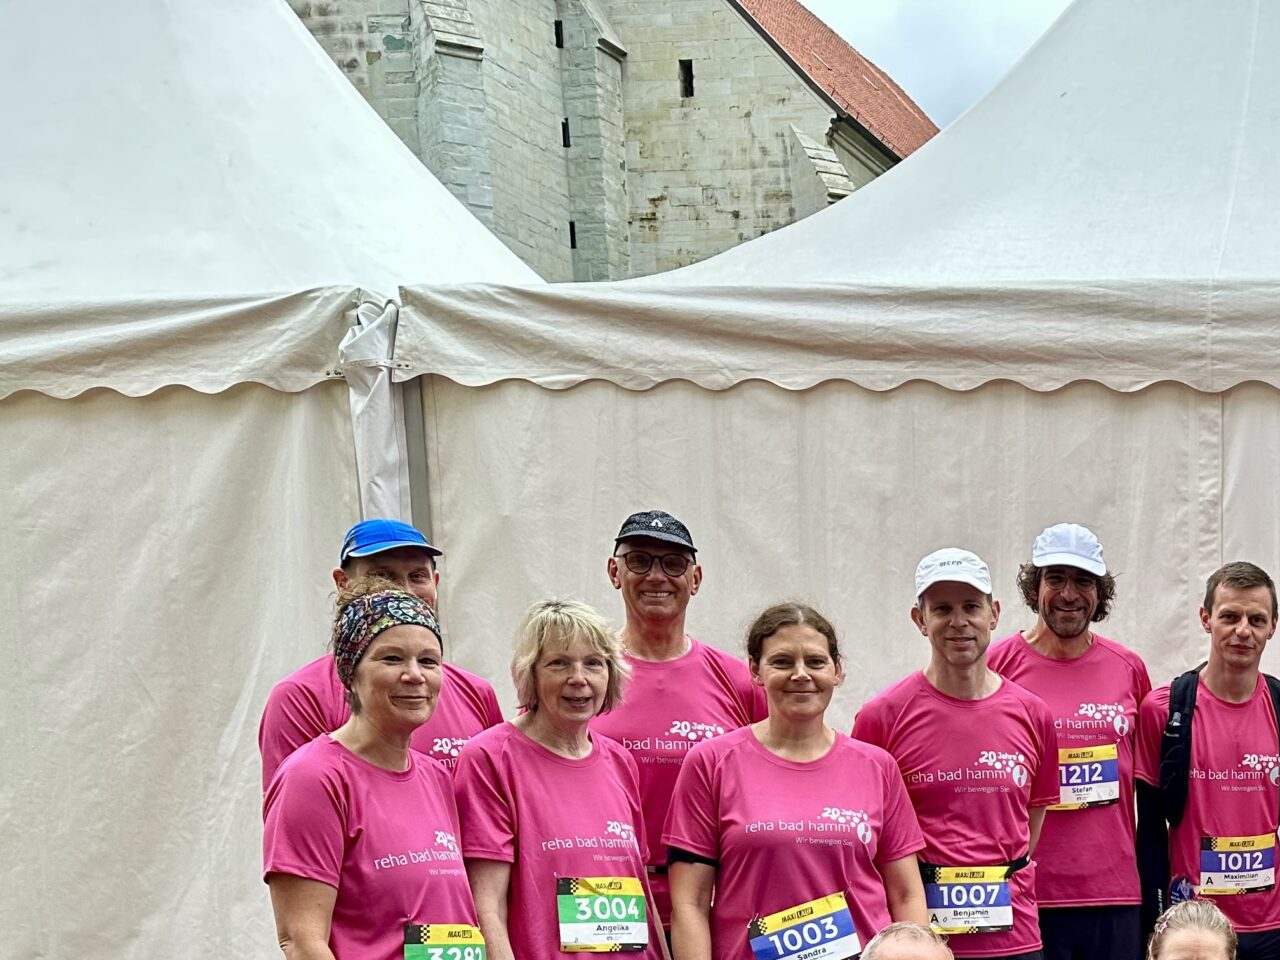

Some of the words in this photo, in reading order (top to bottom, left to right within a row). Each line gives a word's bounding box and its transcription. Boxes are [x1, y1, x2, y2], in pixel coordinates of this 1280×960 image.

[1079, 703, 1096, 715] 20
[1097, 703, 1117, 711] Jahre
[671, 721, 691, 734] 20
[1066, 718, 1107, 729] hamm
[433, 738, 451, 750] 20
[622, 737, 651, 750] bad
[641, 756, 655, 764] Wir
[980, 751, 997, 764] 20
[998, 752, 1018, 760] Jahre
[1242, 753, 1258, 766] 20
[907, 768, 933, 783] reha
[937, 768, 962, 781] bad
[966, 768, 1006, 780] hamm
[1059, 763, 1103, 784] 1212
[1189, 768, 1206, 779] eha
[1208, 768, 1228, 780] bad
[1231, 768, 1264, 780] hamm
[967, 786, 999, 794] bewegen
[822, 808, 840, 819] 20
[607, 821, 621, 832] 20
[745, 820, 774, 834] reha
[778, 820, 804, 832] bad
[808, 820, 850, 833] hamm
[541, 836, 573, 851] reha
[576, 835, 597, 848] bad
[599, 836, 633, 849] hamm
[809, 837, 842, 846] bewegen
[374, 853, 408, 870] reha
[408, 848, 432, 863] bad
[1218, 852, 1263, 871] 1012
[1205, 876, 1214, 885] A
[1223, 872, 1259, 880] Maximilian
[939, 885, 1000, 906] 1007
[575, 897, 640, 920] 3004
[953, 909, 989, 918] Benjamin
[930, 913, 939, 923] A
[596, 924, 629, 932] Angelika
[769, 916, 839, 956] 1003
[797, 947, 827, 960] Sandra
